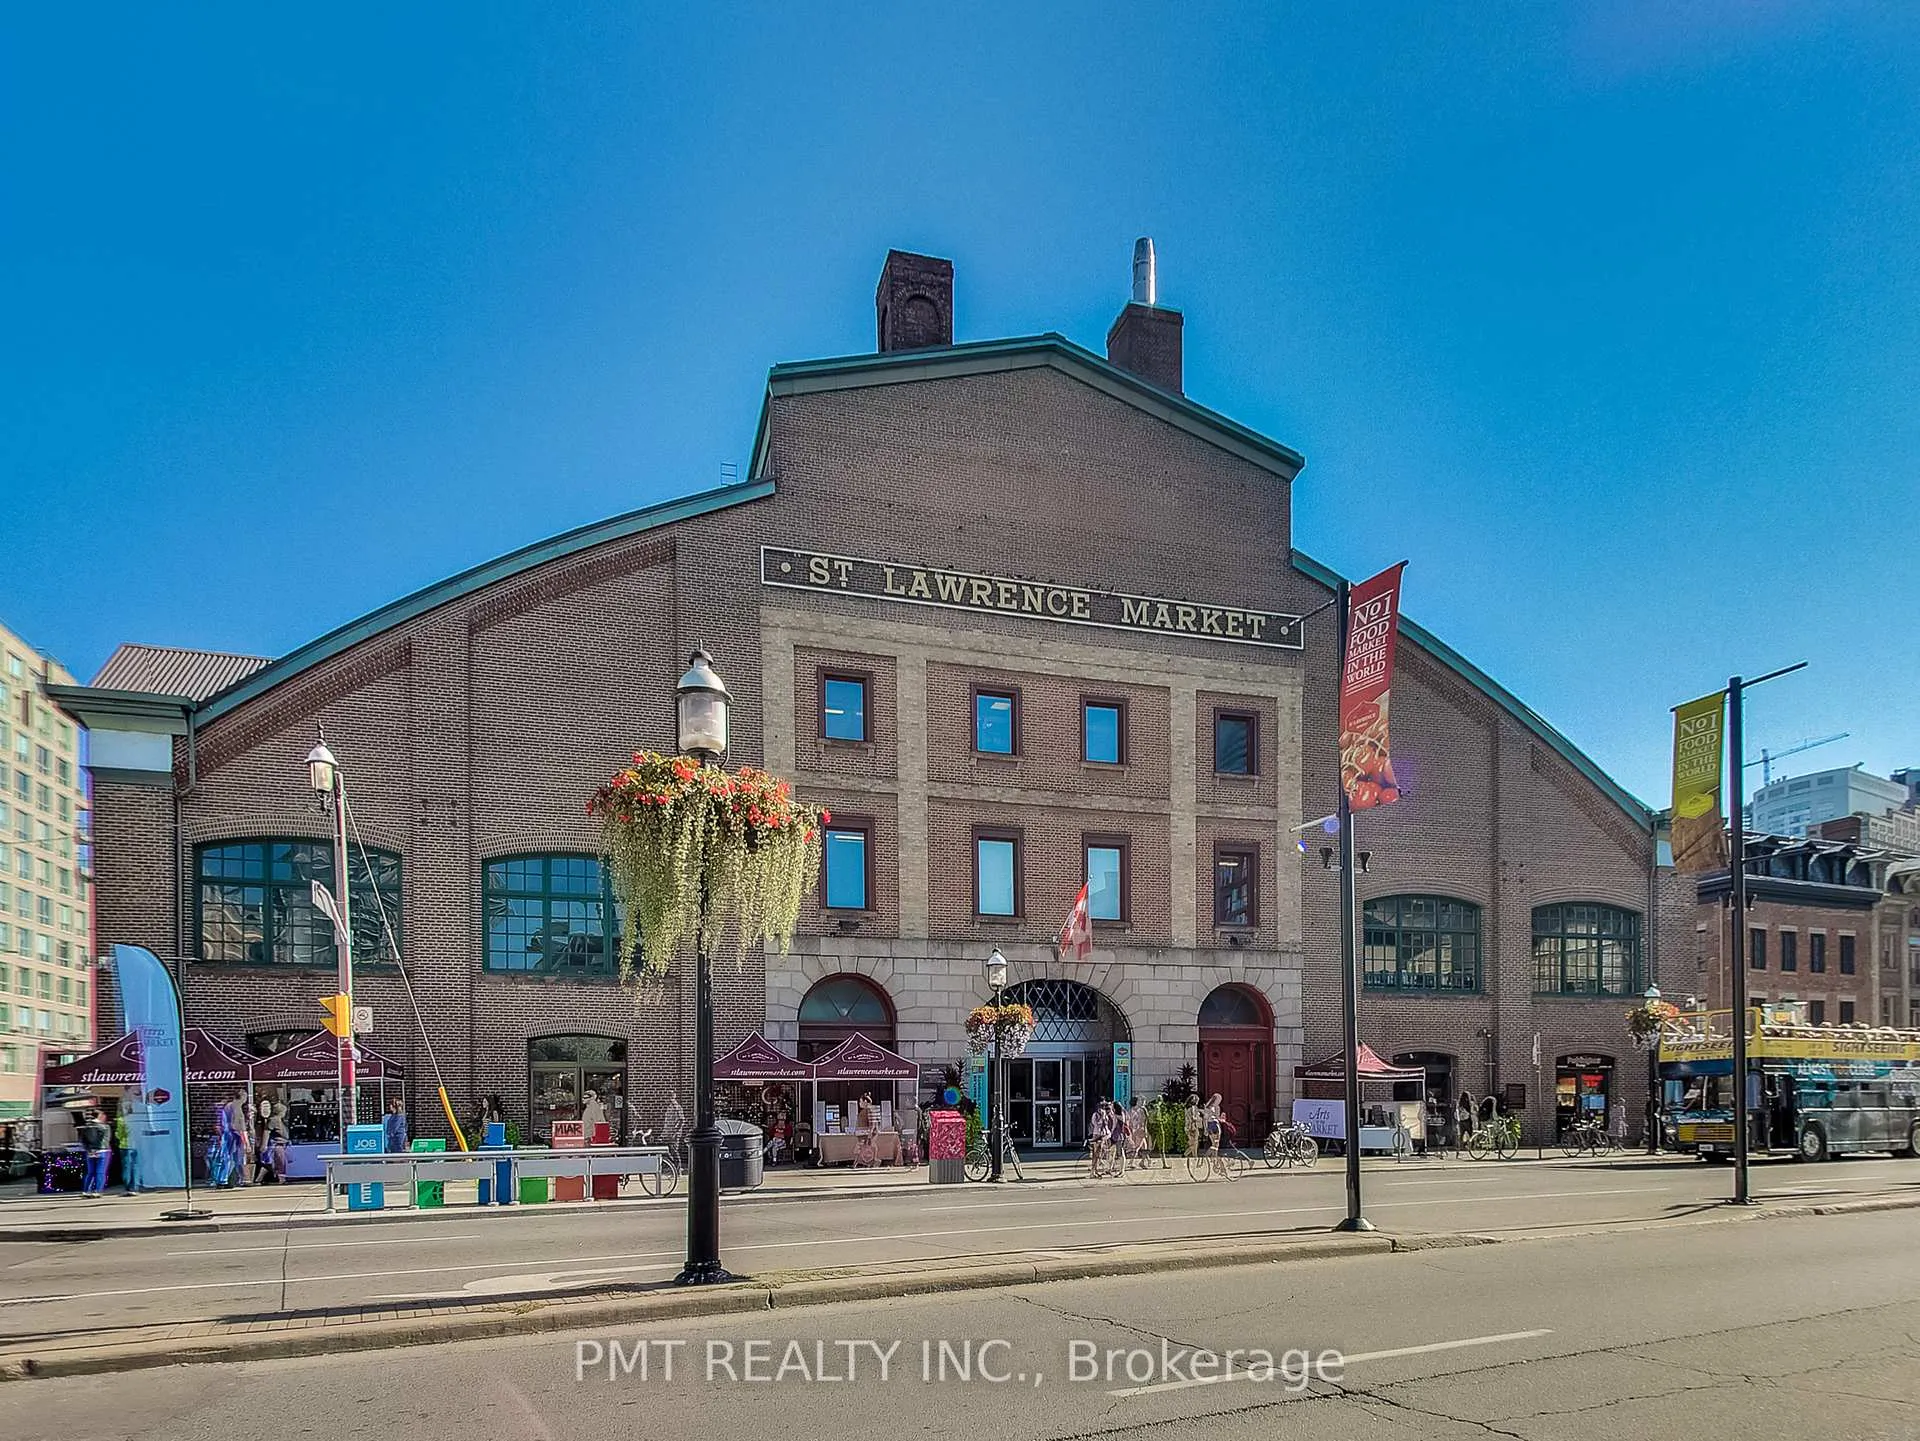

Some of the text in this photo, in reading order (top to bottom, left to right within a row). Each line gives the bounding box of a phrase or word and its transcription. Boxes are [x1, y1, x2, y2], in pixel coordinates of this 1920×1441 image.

[883, 567, 1091, 619] LAWRENCE
[1120, 598, 1266, 640] MARKET
[1350, 621, 1389, 649] FOOD
[1348, 634, 1388, 659] MARKET
[1347, 648, 1387, 675] IN THE
[1346, 661, 1386, 684] WORLD
[1680, 733, 1718, 752] FOOD
[1691, 754, 1715, 768] THE
[1664, 1039, 1752, 1052] SIGHTSEEI
[1832, 1042, 1906, 1054] SIGHTSEEING
[81, 1067, 235, 1082] stlawrencket.com
[836, 1067, 910, 1076] stlawrencemarket.com
[1309, 1107, 1331, 1120] Arts
[354, 1139, 377, 1149] JOB
